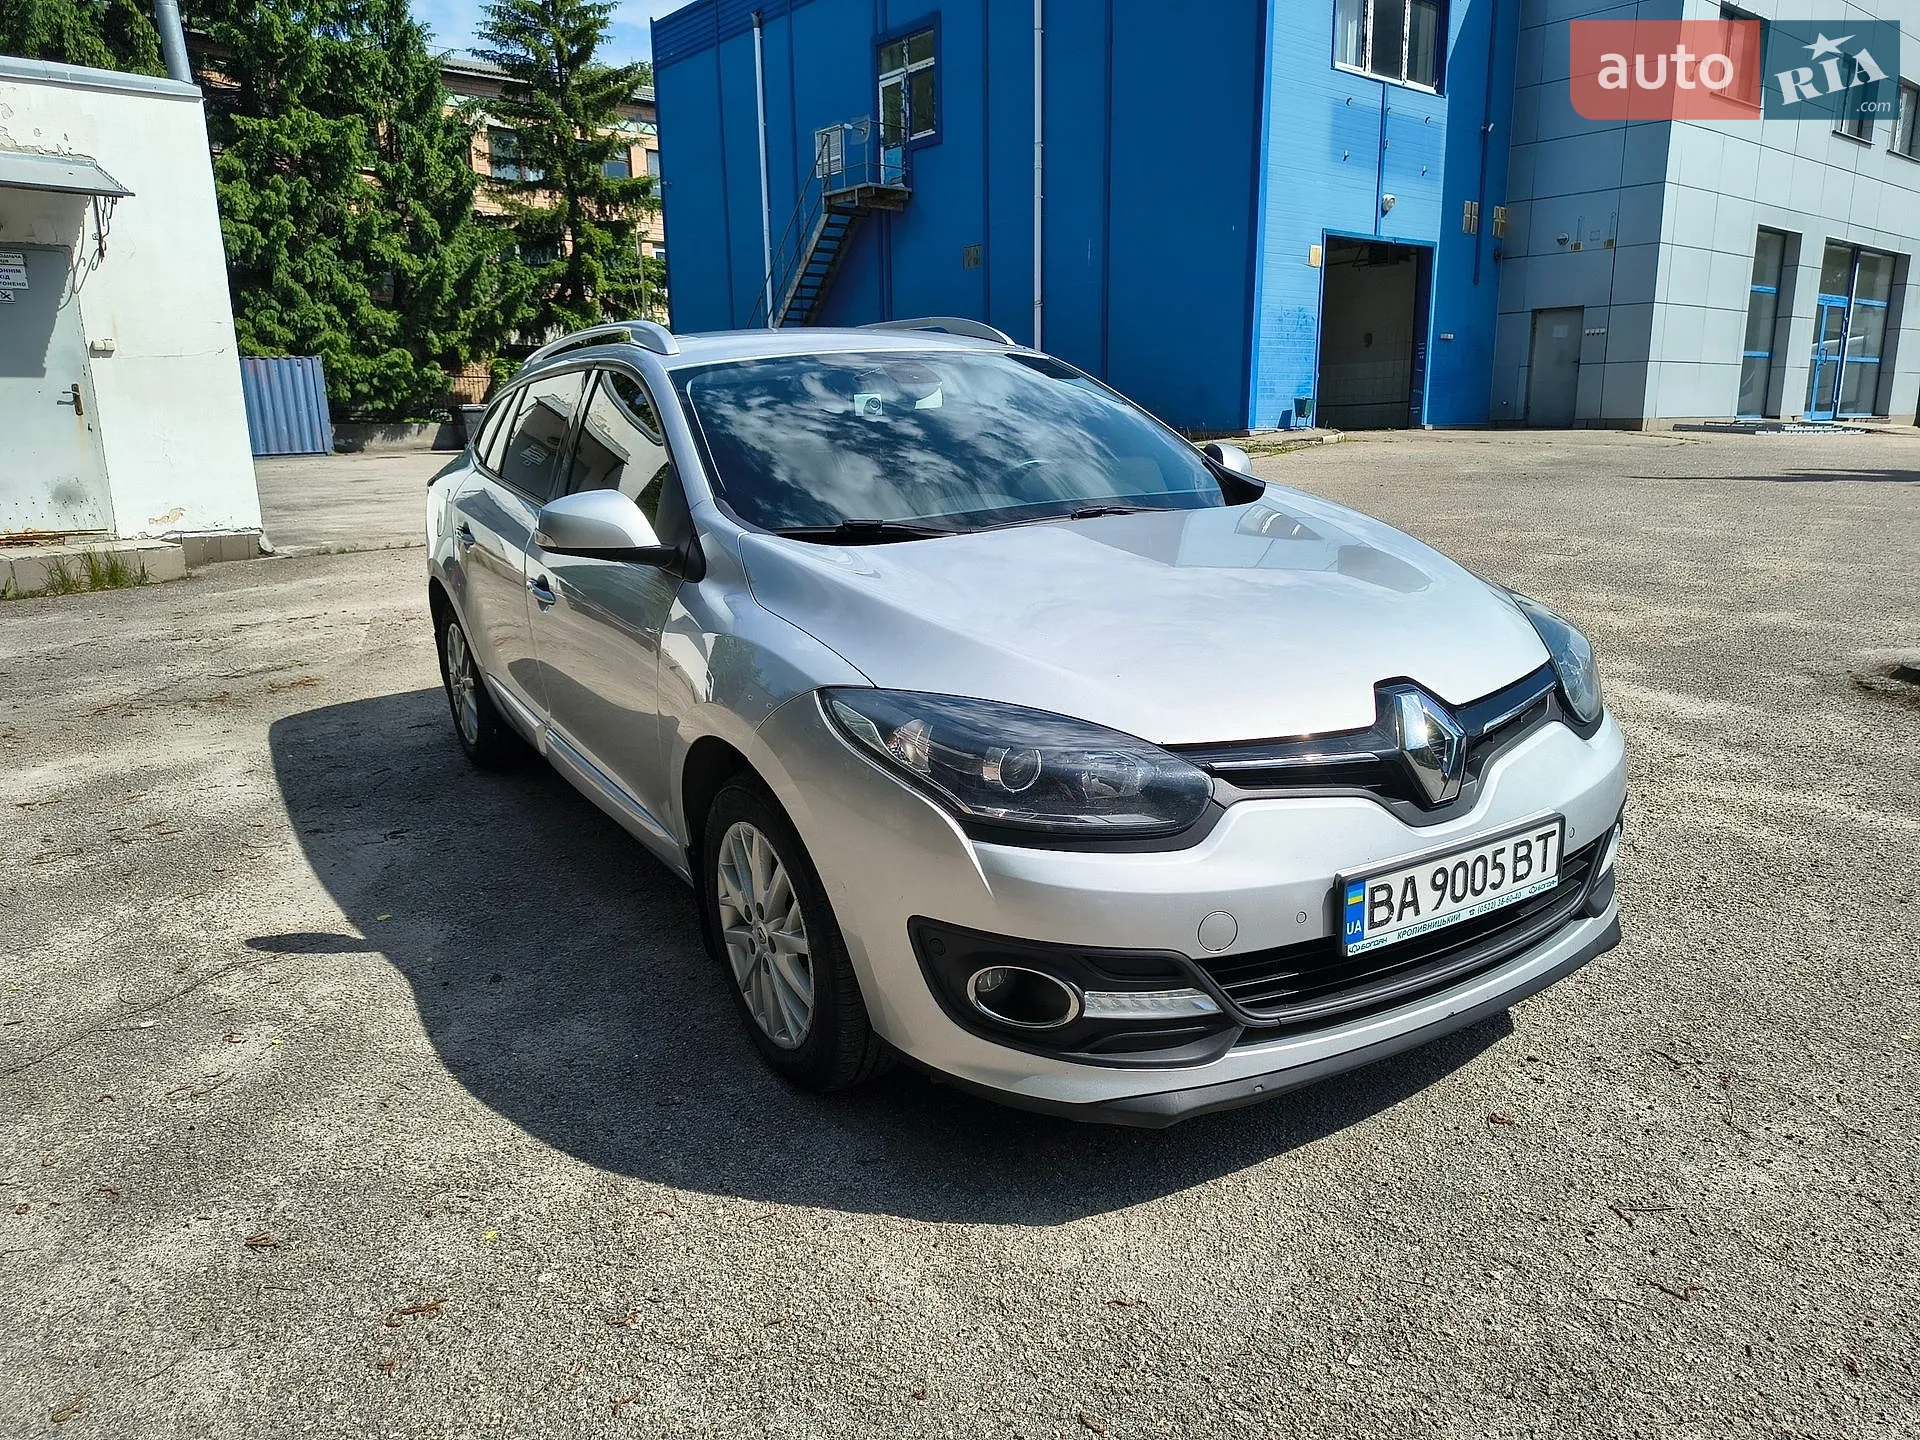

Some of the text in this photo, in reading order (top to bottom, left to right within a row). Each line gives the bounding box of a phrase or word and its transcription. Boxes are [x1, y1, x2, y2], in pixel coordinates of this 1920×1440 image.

[1367, 829, 1557, 930] BA 9005 BT
[1346, 919, 1362, 935] UA
[1397, 913, 1461, 940] КРОПИВНИЦЬКИЙ
